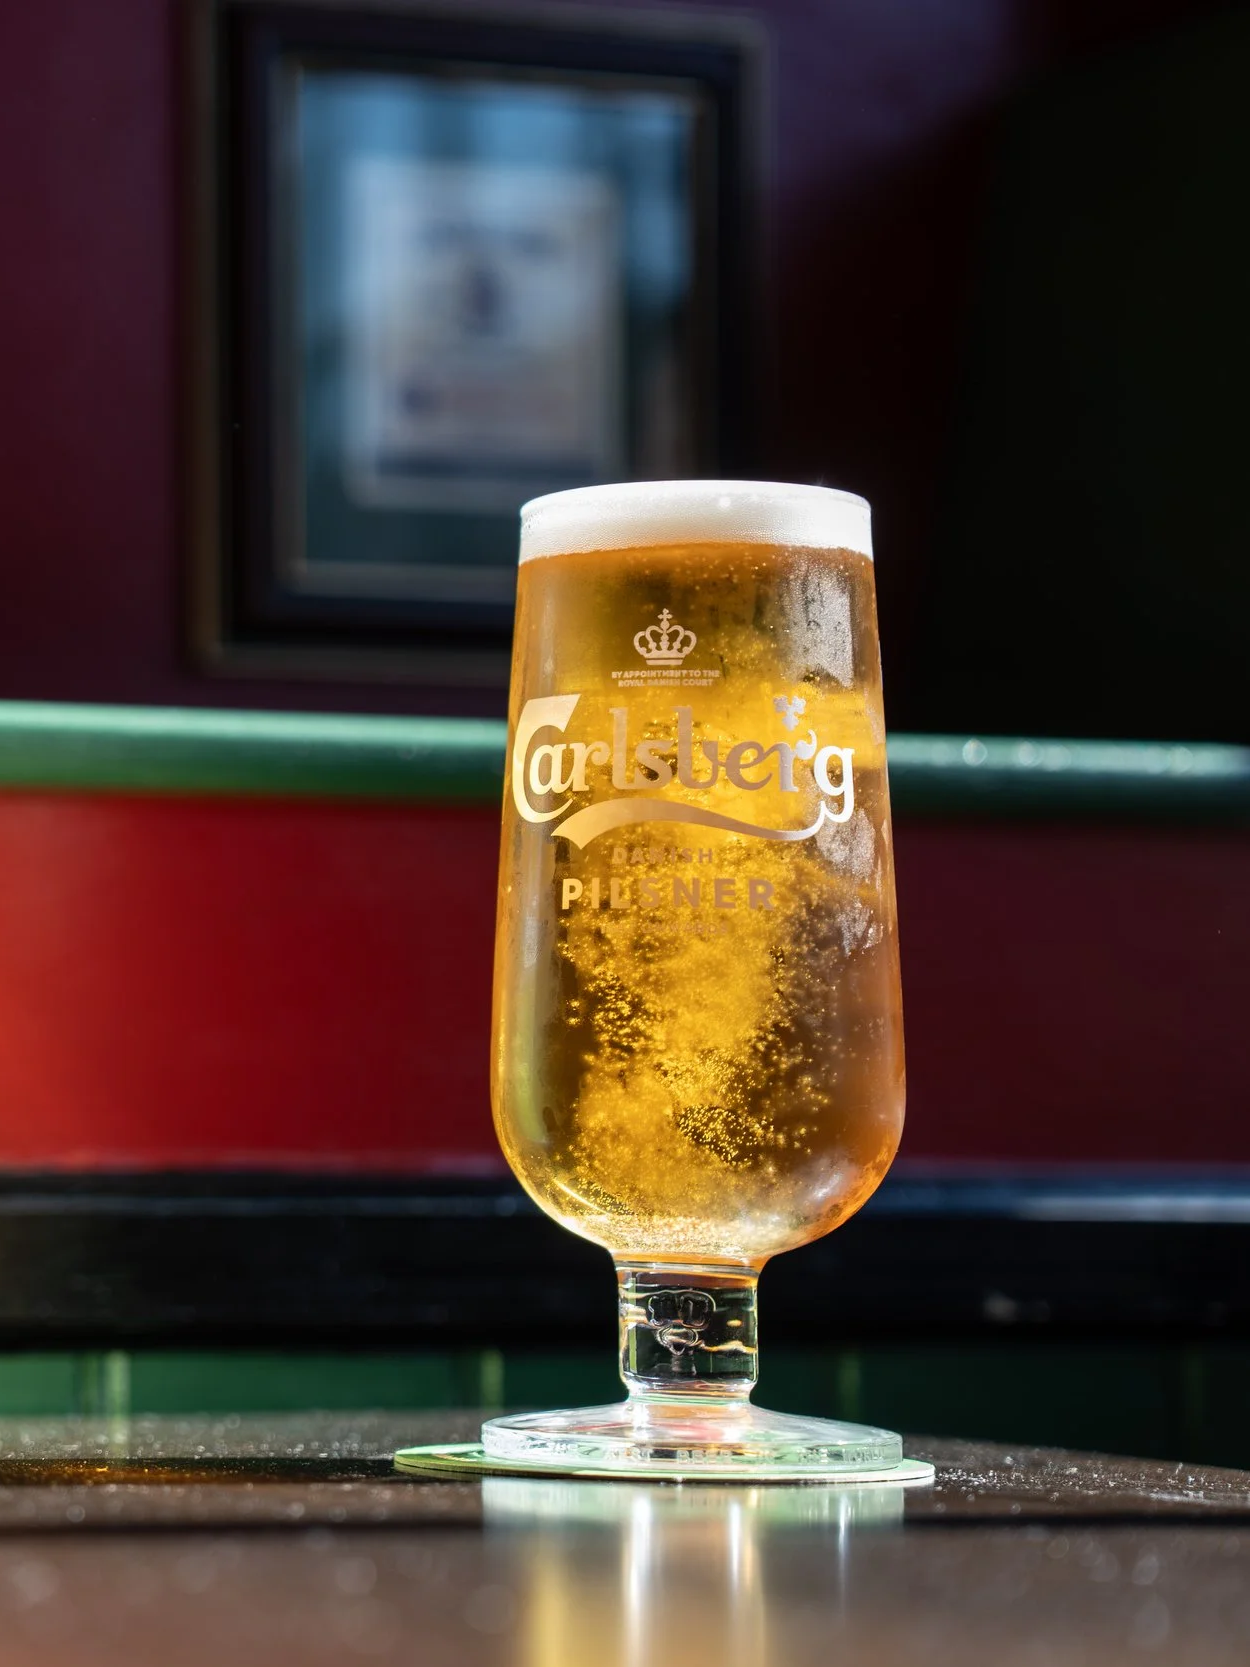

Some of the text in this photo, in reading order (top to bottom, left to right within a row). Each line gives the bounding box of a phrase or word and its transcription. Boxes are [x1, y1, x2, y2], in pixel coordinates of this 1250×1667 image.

[611, 669, 720, 679] BY APPOINTMENT TO THE
[618, 680, 645, 688] ROYAL
[681, 679, 714, 687] COURT
[512, 694, 855, 824] Carlsberg
[612, 847, 713, 865] DANISH
[561, 877, 775, 911] PILSNER
